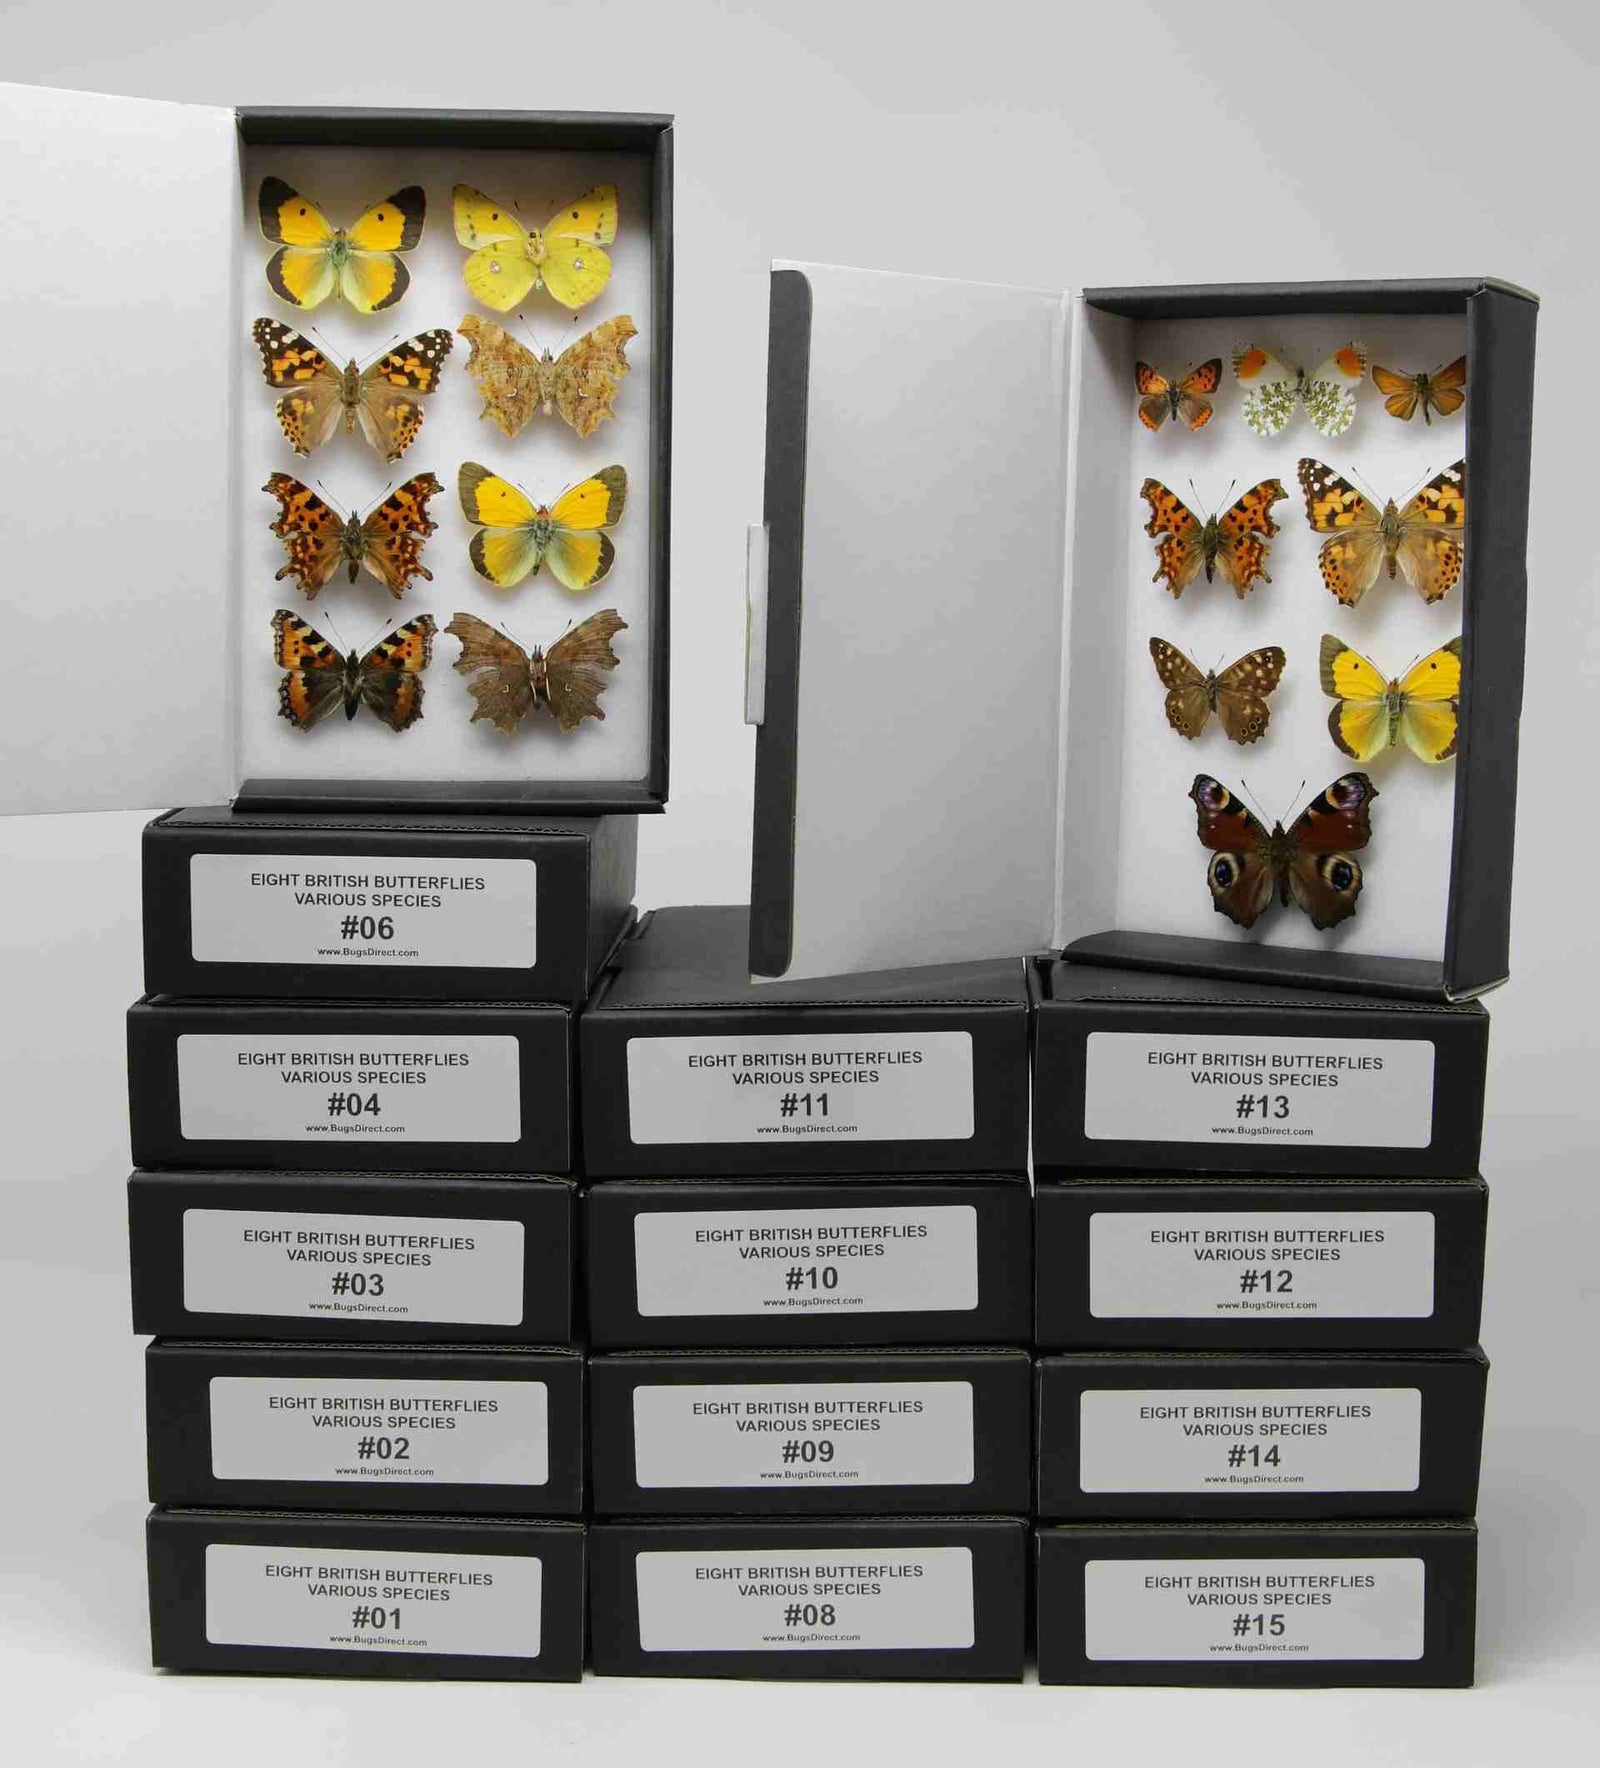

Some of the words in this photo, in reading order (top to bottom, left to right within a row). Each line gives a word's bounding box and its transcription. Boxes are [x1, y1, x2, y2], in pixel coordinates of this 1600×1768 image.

[251, 872, 301, 887] EIGHT
[305, 873, 369, 888] BRITISH
[374, 875, 486, 891] BUTTERFLIES
[294, 891, 367, 907] VARIOUS
[371, 893, 442, 908] SPECIES
[340, 914, 395, 941] #06
[316, 947, 419, 959] www.BugsDirect.com
[237, 1052, 287, 1066] EIGHT
[291, 1052, 354, 1066] BRITISH
[359, 1052, 470, 1067] BUTTERFLIES
[688, 1054, 738, 1068] EIGHT
[742, 1052, 807, 1067] BRITISH
[811, 1050, 923, 1066] BUTTERFLIES
[1147, 1051, 1198, 1066] EIGHT
[1202, 1052, 1267, 1068] BRITISH
[1271, 1054, 1384, 1070] BUTTERFLIES
[280, 1070, 353, 1084] VARIOUS
[357, 1071, 427, 1085] SPECIES
[731, 1071, 805, 1086] VARIOUS
[809, 1070, 880, 1085] SPECIES
[1190, 1071, 1264, 1086] VARIOUS
[1268, 1073, 1339, 1088] SPECIES
[327, 1091, 382, 1117] #04
[779, 1092, 829, 1118] #11
[1235, 1093, 1290, 1120] #13
[304, 1123, 406, 1135] www.BugsDirect.com
[756, 1123, 858, 1136] www.BugsDirect.com
[1211, 1125, 1314, 1137] www.BugsDirect.com
[243, 1229, 293, 1244] EIGHT
[296, 1231, 360, 1247] BRITISH
[365, 1233, 475, 1251] BUTTERFLIES
[695, 1229, 745, 1243] EIGHT
[749, 1227, 813, 1242] BRITISH
[817, 1224, 928, 1240] BUTTERFLIES
[1150, 1230, 1201, 1244] EIGHT
[1204, 1230, 1269, 1244] BRITISH
[1273, 1229, 1385, 1244] BUTTERFLIES
[286, 1248, 358, 1264] VARIOUS
[362, 1251, 432, 1267] SPECIES
[738, 1245, 811, 1260] VARIOUS
[815, 1243, 885, 1258] SPECIES
[1193, 1248, 1267, 1261] VARIOUS
[1271, 1247, 1341, 1261] SPECIES
[331, 1271, 385, 1297] #03
[785, 1266, 839, 1292] #10
[1239, 1269, 1294, 1294] #12
[307, 1302, 409, 1314] www.BugsDirect.com
[762, 1296, 864, 1308] www.BugsDirect.com
[1216, 1300, 1318, 1311] www.BugsDirect.com
[268, 1396, 318, 1410] EIGHT
[322, 1397, 385, 1411] BRITISH
[389, 1398, 499, 1413] BUTTERFLIES
[692, 1402, 741, 1415] EIGHT
[746, 1401, 810, 1415] BRITISH
[814, 1400, 924, 1414] BUTTERFLIES
[1140, 1406, 1190, 1420] EIGHT
[1193, 1406, 1257, 1419] BRITISH
[1261, 1405, 1372, 1419] BUTTERFLIES
[311, 1414, 383, 1428] VARIOUS
[387, 1415, 456, 1430] SPECIES
[735, 1419, 807, 1433] VARIOUS
[812, 1418, 881, 1432] SPECIES
[1182, 1423, 1254, 1437] VARIOUS
[1259, 1422, 1328, 1436] SPECIES
[357, 1435, 410, 1460] #02
[781, 1439, 835, 1464] #09
[1227, 1444, 1281, 1468] #14
[334, 1466, 435, 1477] www.BugsDirect.com
[759, 1469, 859, 1481] www.BugsDirect.com
[1204, 1474, 1304, 1486] www.BugsDirect.com
[265, 1564, 314, 1579] EIGHT
[318, 1566, 381, 1581] BRITISH
[385, 1569, 493, 1586] BUTTERFLIES
[695, 1567, 743, 1580] EIGHT
[747, 1566, 811, 1580] BRITISH
[815, 1565, 924, 1579] BUTTERFLIES
[737, 1583, 809, 1597] VARIOUS
[813, 1583, 881, 1596] SPECIES
[1144, 1576, 1193, 1589] EIGHT
[1197, 1575, 1261, 1589] BRITISH
[1265, 1575, 1376, 1588] BUTTERFLIES
[307, 1583, 378, 1598] VARIOUS
[382, 1586, 450, 1602] SPECIES
[1187, 1593, 1259, 1606] VARIOUS
[1263, 1593, 1332, 1606] SPECIES
[351, 1605, 401, 1630] #01
[783, 1603, 836, 1627] #08
[1232, 1613, 1286, 1637] #15
[329, 1635, 428, 1647] www.BugsDirect.com
[762, 1633, 861, 1643] www.BugsDirect.com
[1208, 1643, 1309, 1654] www.BugsDirect.com
